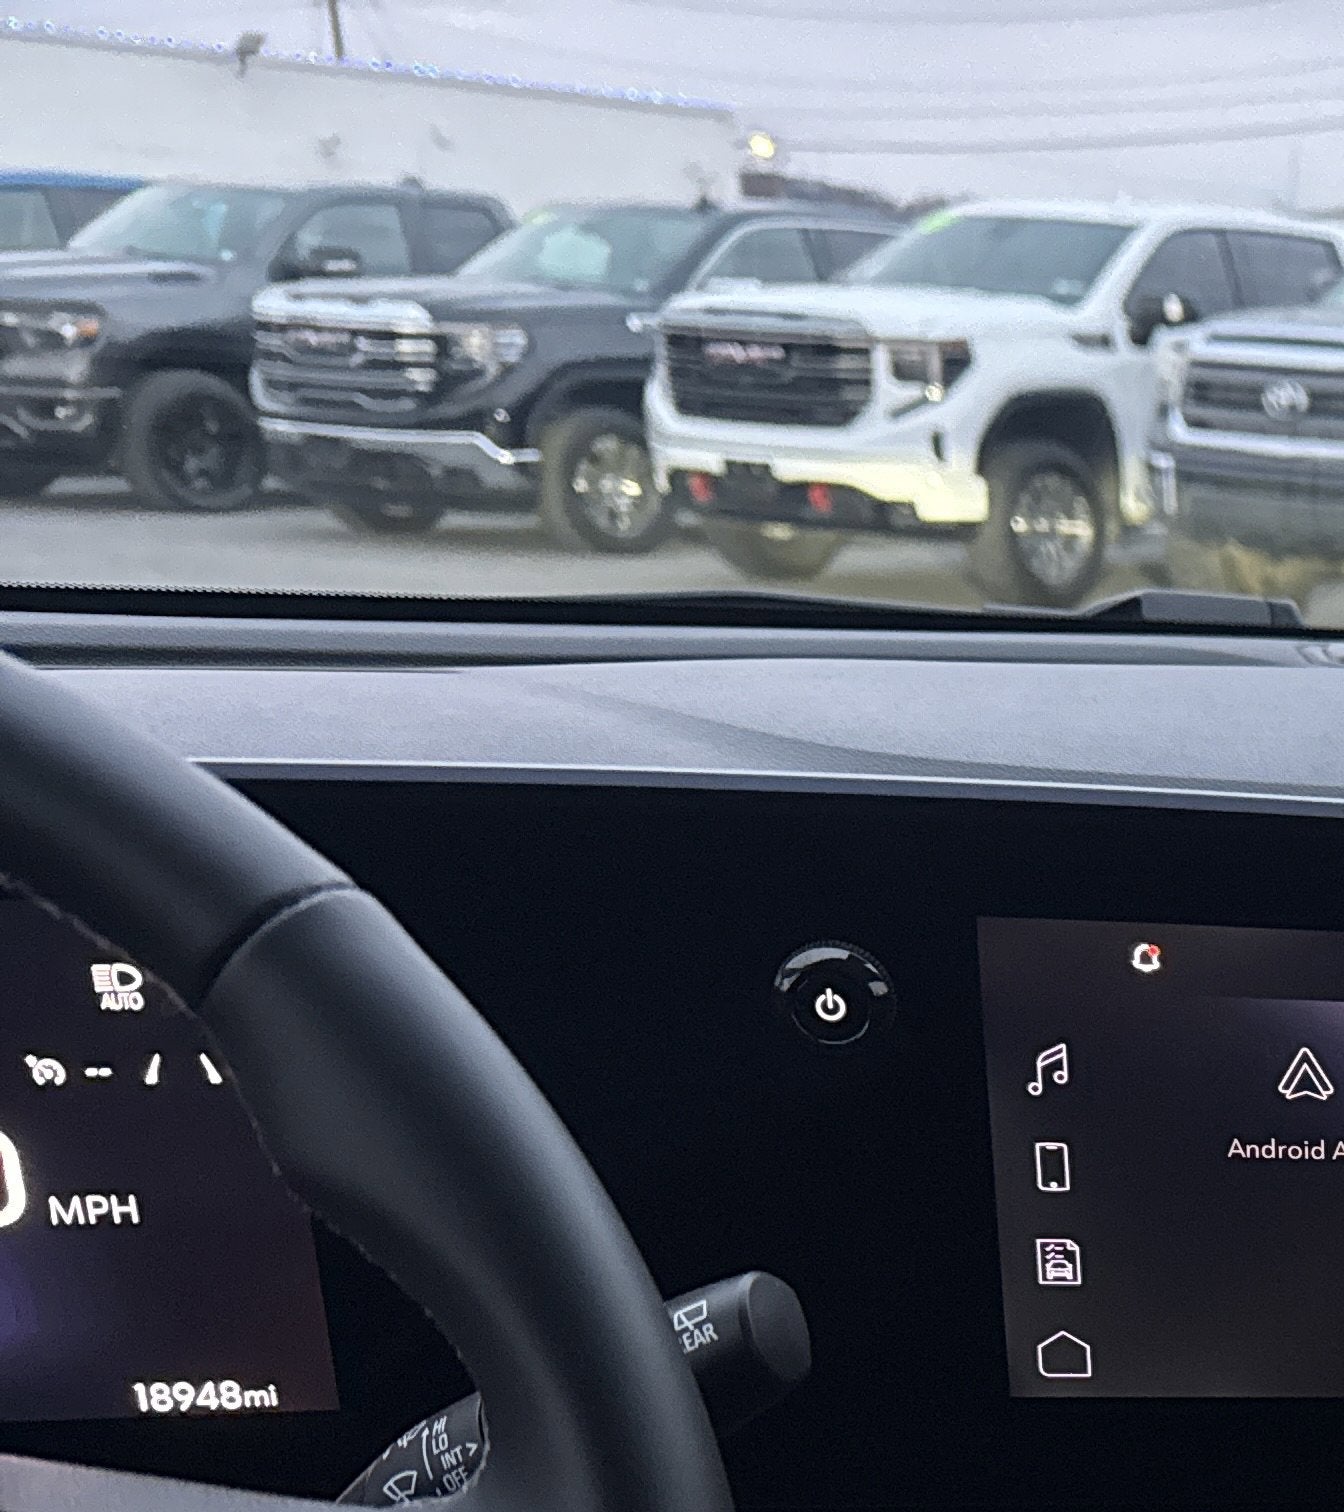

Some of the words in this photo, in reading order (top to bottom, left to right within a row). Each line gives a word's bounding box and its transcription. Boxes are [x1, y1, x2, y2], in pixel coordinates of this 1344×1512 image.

[100, 991, 144, 1012] AUTO
[1227, 1138, 1326, 1161] Android
[48, 1194, 141, 1227] MPH
[678, 1323, 718, 1354] EAR
[431, 1432, 449, 1456] LO
[440, 1444, 463, 1471] INT
[442, 1465, 469, 1493] OFF
